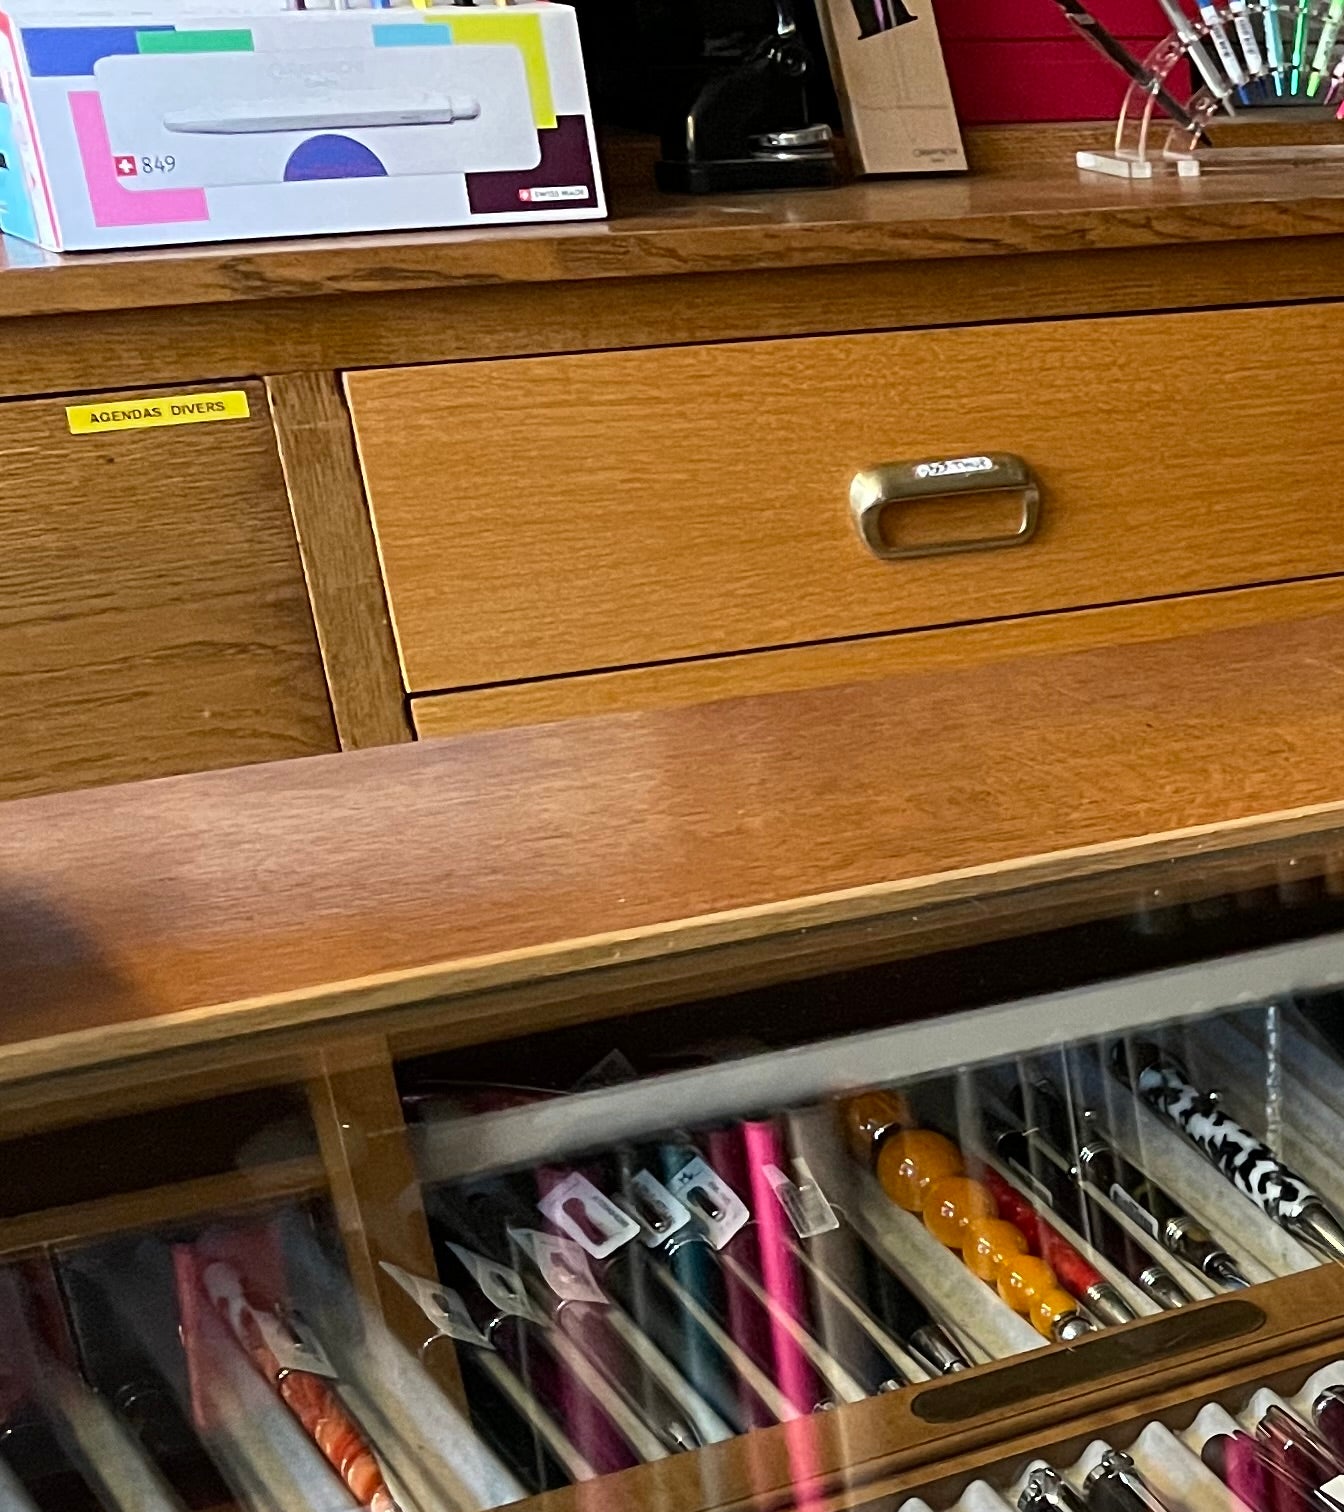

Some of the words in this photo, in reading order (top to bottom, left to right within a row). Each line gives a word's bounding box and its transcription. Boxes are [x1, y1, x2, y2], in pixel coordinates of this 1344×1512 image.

[141, 155, 176, 174] 849
[89, 406, 163, 424] AGENDAS
[170, 400, 226, 416] DIVERS
